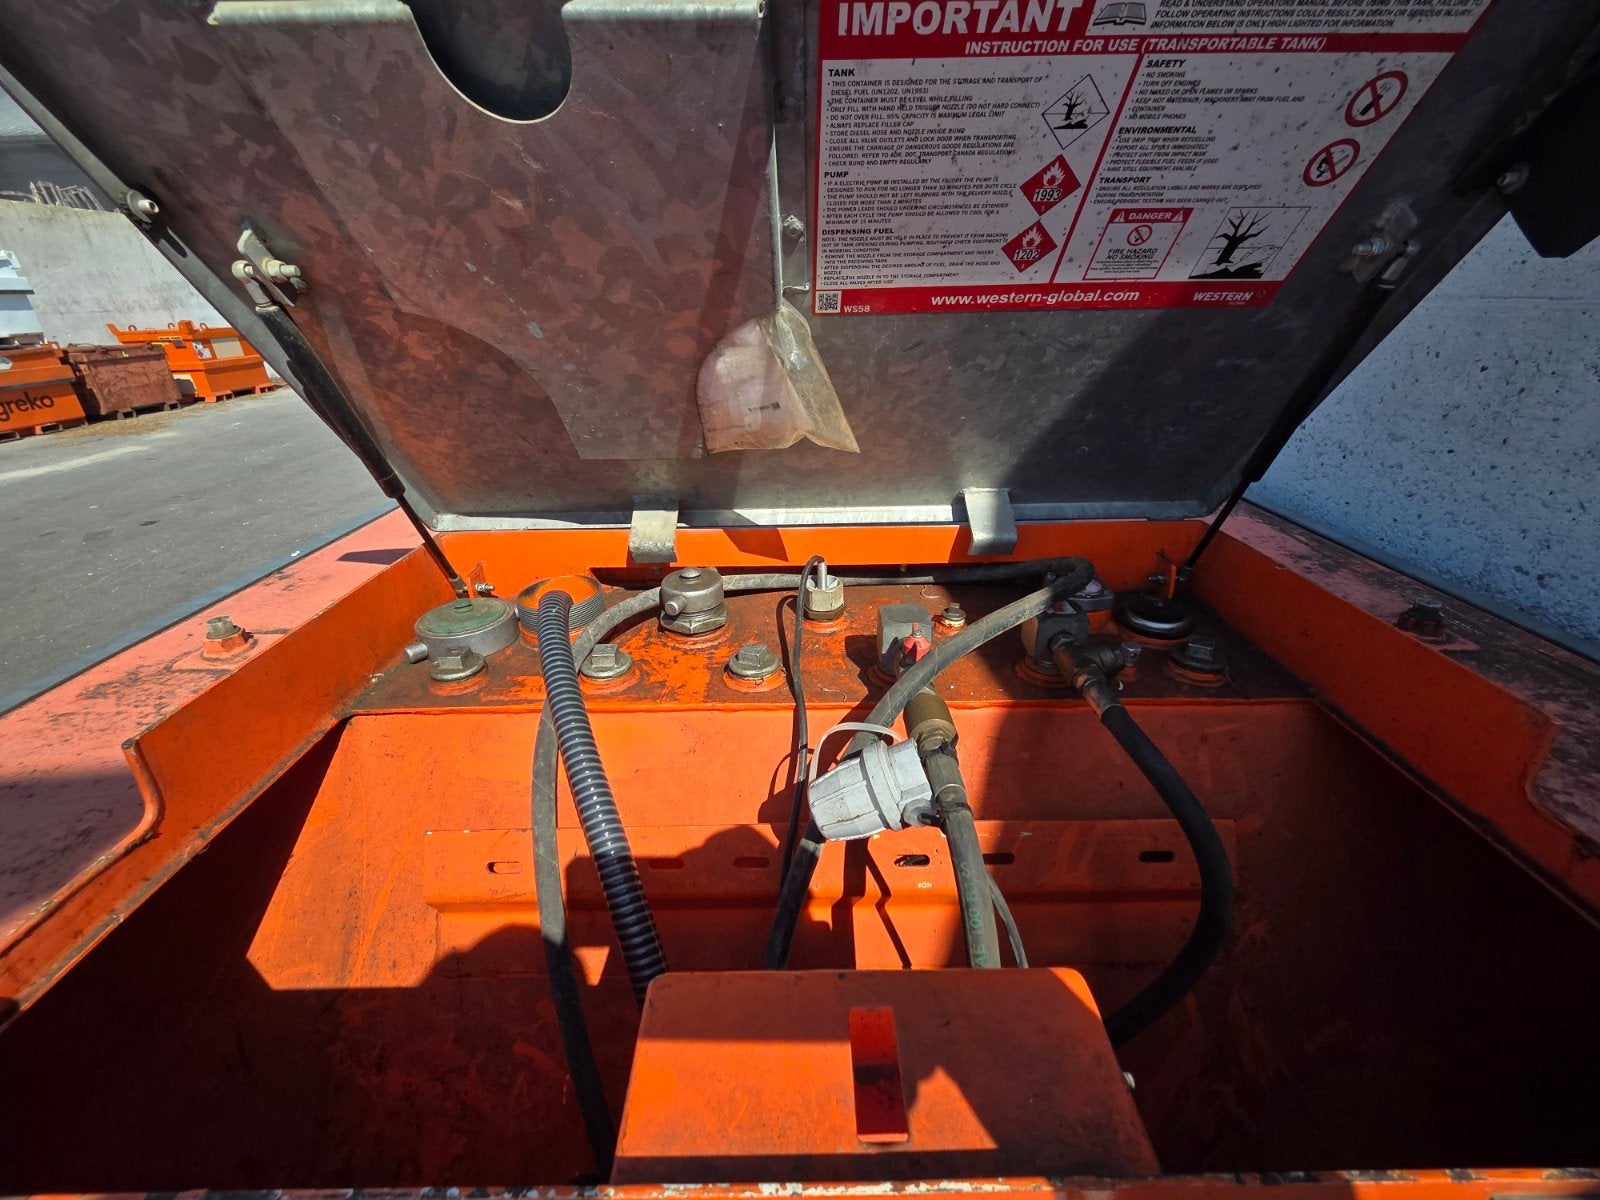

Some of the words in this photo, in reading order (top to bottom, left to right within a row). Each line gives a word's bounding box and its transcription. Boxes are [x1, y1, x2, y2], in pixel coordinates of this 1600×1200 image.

[838, 0, 1084, 36] IMPORTANT
[1155, 10, 1190, 18] FOLLOW
[1191, 10, 1237, 18] OPERATING
[1237, 9, 1295, 17] INSTRUCTIONS
[1296, 9, 1325, 17] COULD
[1325, 9, 1356, 17] RESULT
[1355, 9, 1366, 17] IN
[1366, 9, 1394, 17] DEATH
[1394, 9, 1408, 17] OR
[1150, 20, 1205, 29] INFORMATION
[1205, 20, 1235, 28] BELOW
[1245, 20, 1266, 29] ONLY
[965, 40, 1070, 54] INSTRUCTION
[1072, 39, 1104, 52] FOR
[1107, 39, 1139, 51] USE
[1141, 37, 1277, 53] (TRANSPORTABLE
[1280, 37, 1327, 51] TANK)
[1146, 59, 1187, 68] SAFETY
[828, 69, 855, 77] TANK
[1118, 126, 1197, 134] ENVIRONMENTAL
[1035, 189, 1061, 201] 1993
[1128, 212, 1172, 220] DANGER
[1015, 250, 1039, 260] 1202
[931, 290, 1140, 305] www.western-global.com
[1193, 292, 1254, 301] WESTERN
[844, 305, 870, 313] WS58
[0, 391, 54, 421] greko
